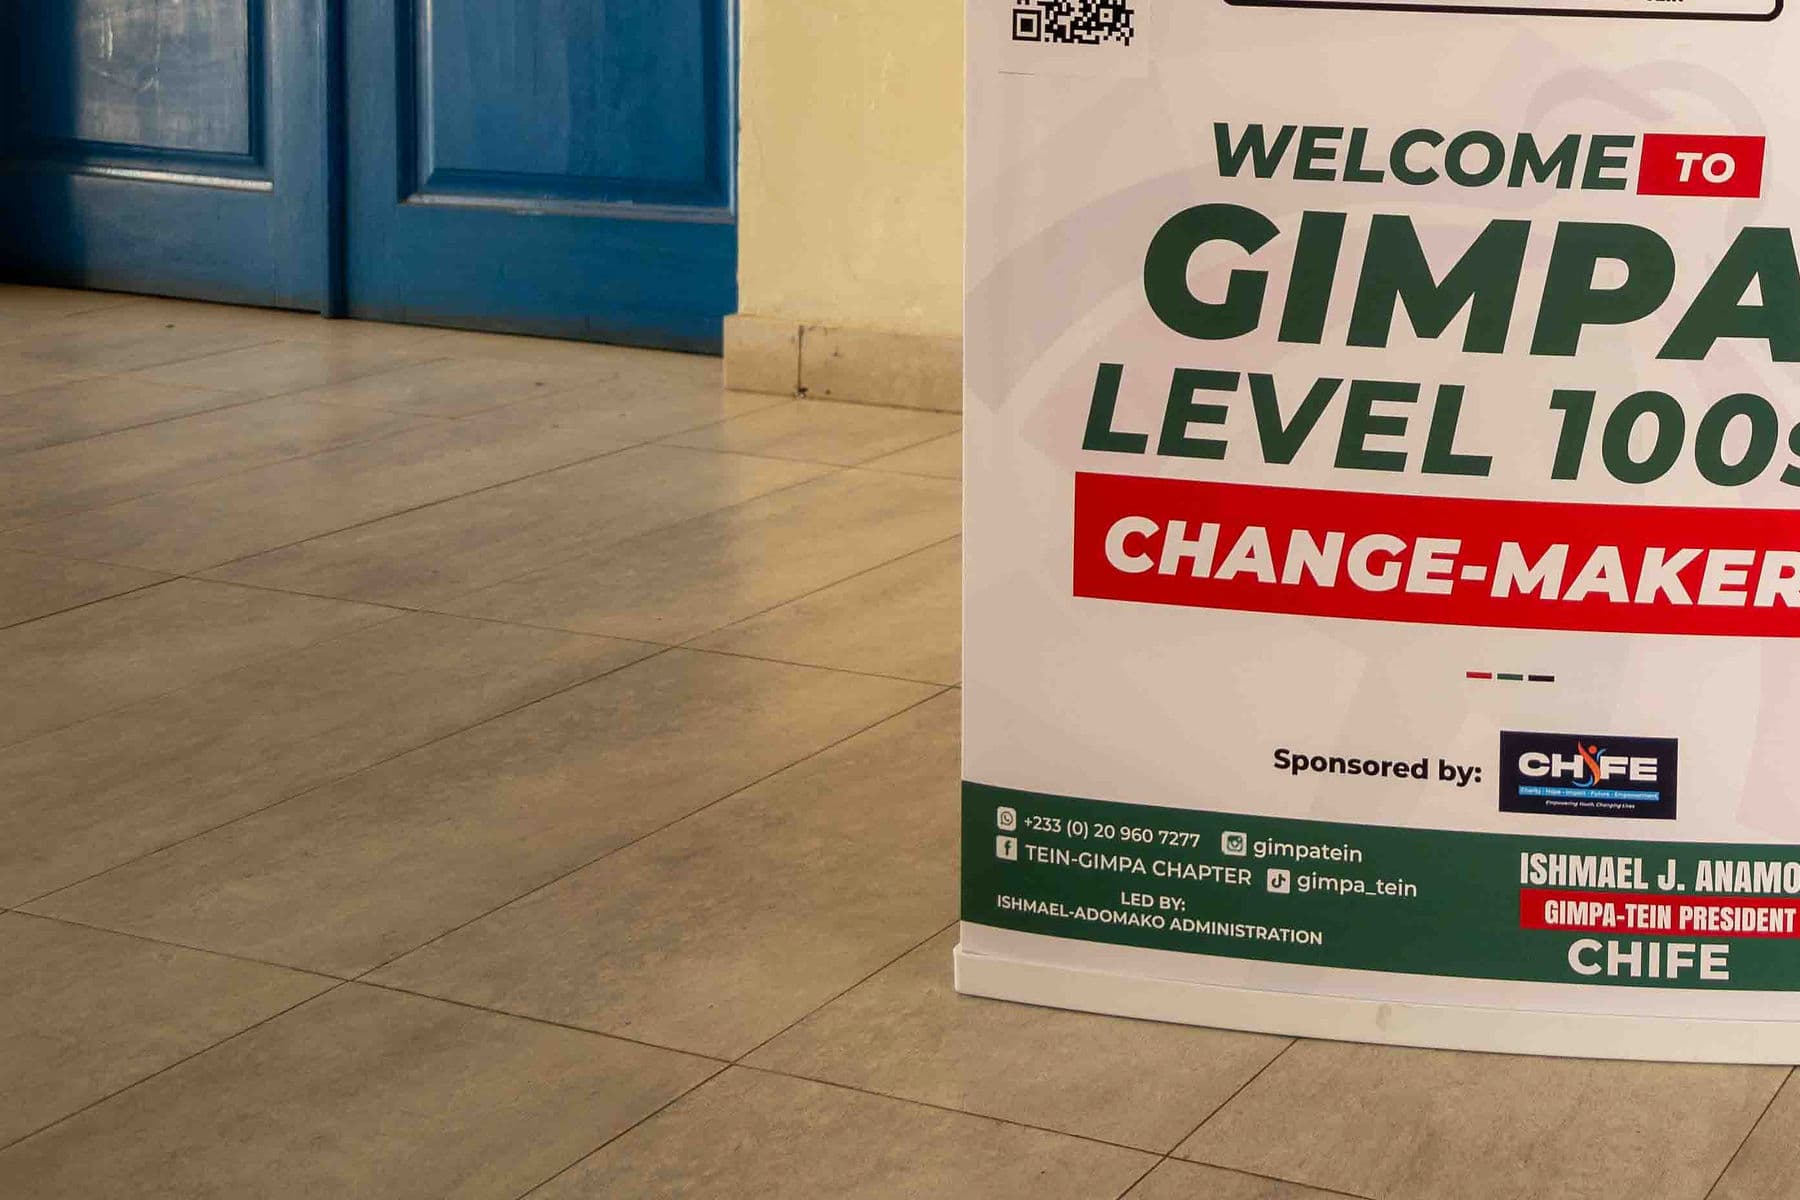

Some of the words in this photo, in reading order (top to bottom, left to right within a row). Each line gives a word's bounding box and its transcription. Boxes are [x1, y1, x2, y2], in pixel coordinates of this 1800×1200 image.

[1213, 122, 1635, 190] WELCOME
[1674, 152, 1736, 183] TO
[1082, 362, 1492, 477] LEVEL
[1274, 748, 1428, 780] Sponsored
[1439, 759, 1482, 787] by:
[1024, 815, 1062, 833] +233
[1066, 819, 1089, 840] (0)
[1094, 823, 1115, 839] 20
[1120, 827, 1153, 844] 960
[1158, 830, 1200, 848] 7277
[1253, 837, 1363, 863] gimpatein
[1024, 844, 1147, 875] TEIN-GIMPA
[1152, 859, 1252, 886] CHAPTER
[1297, 871, 1418, 897] gimpa_tein
[1520, 851, 1649, 890] ISHMAEL
[1657, 859, 1686, 892] J.
[997, 894, 1165, 929] ISHMAEL-ADOMAKO
[1169, 917, 1323, 945] ADMINISTRATION
[1121, 891, 1154, 908] LED
[1159, 896, 1186, 911] BY:
[1544, 899, 1671, 929] GIMPA-TEIN
[1679, 905, 1797, 933] PRESIDENT
[1568, 938, 1730, 981] CHIFE
